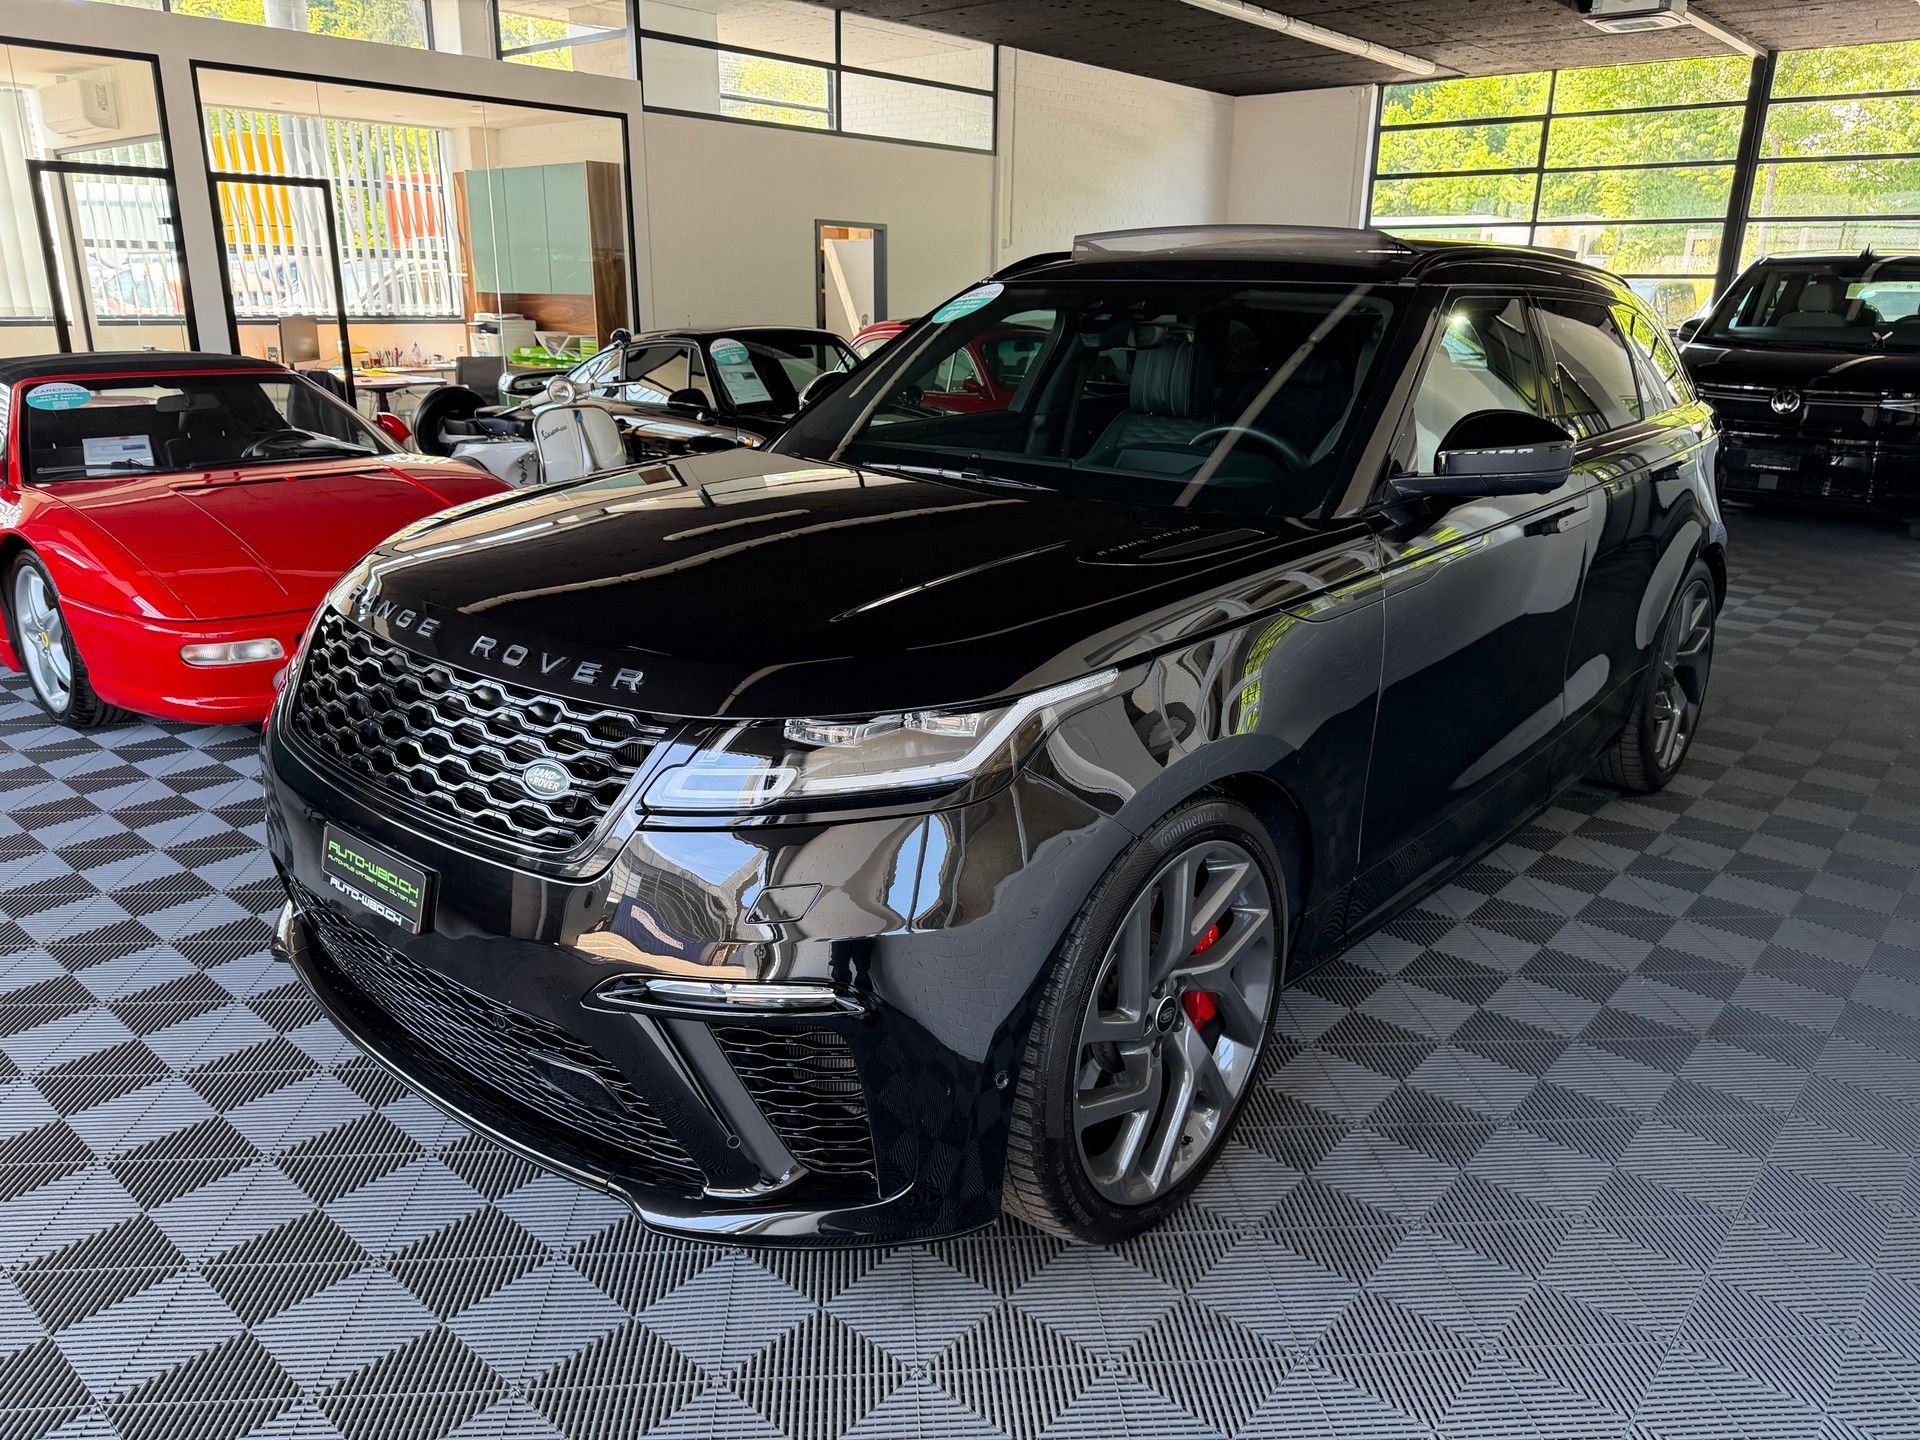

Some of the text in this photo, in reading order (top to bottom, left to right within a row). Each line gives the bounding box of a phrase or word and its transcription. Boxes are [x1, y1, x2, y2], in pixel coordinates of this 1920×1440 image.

[349, 583, 646, 694] RANGE ROVER
[532, 776, 560, 791] ROVER
[533, 767, 556, 780] LAND
[1160, 809, 1217, 849] Continental
